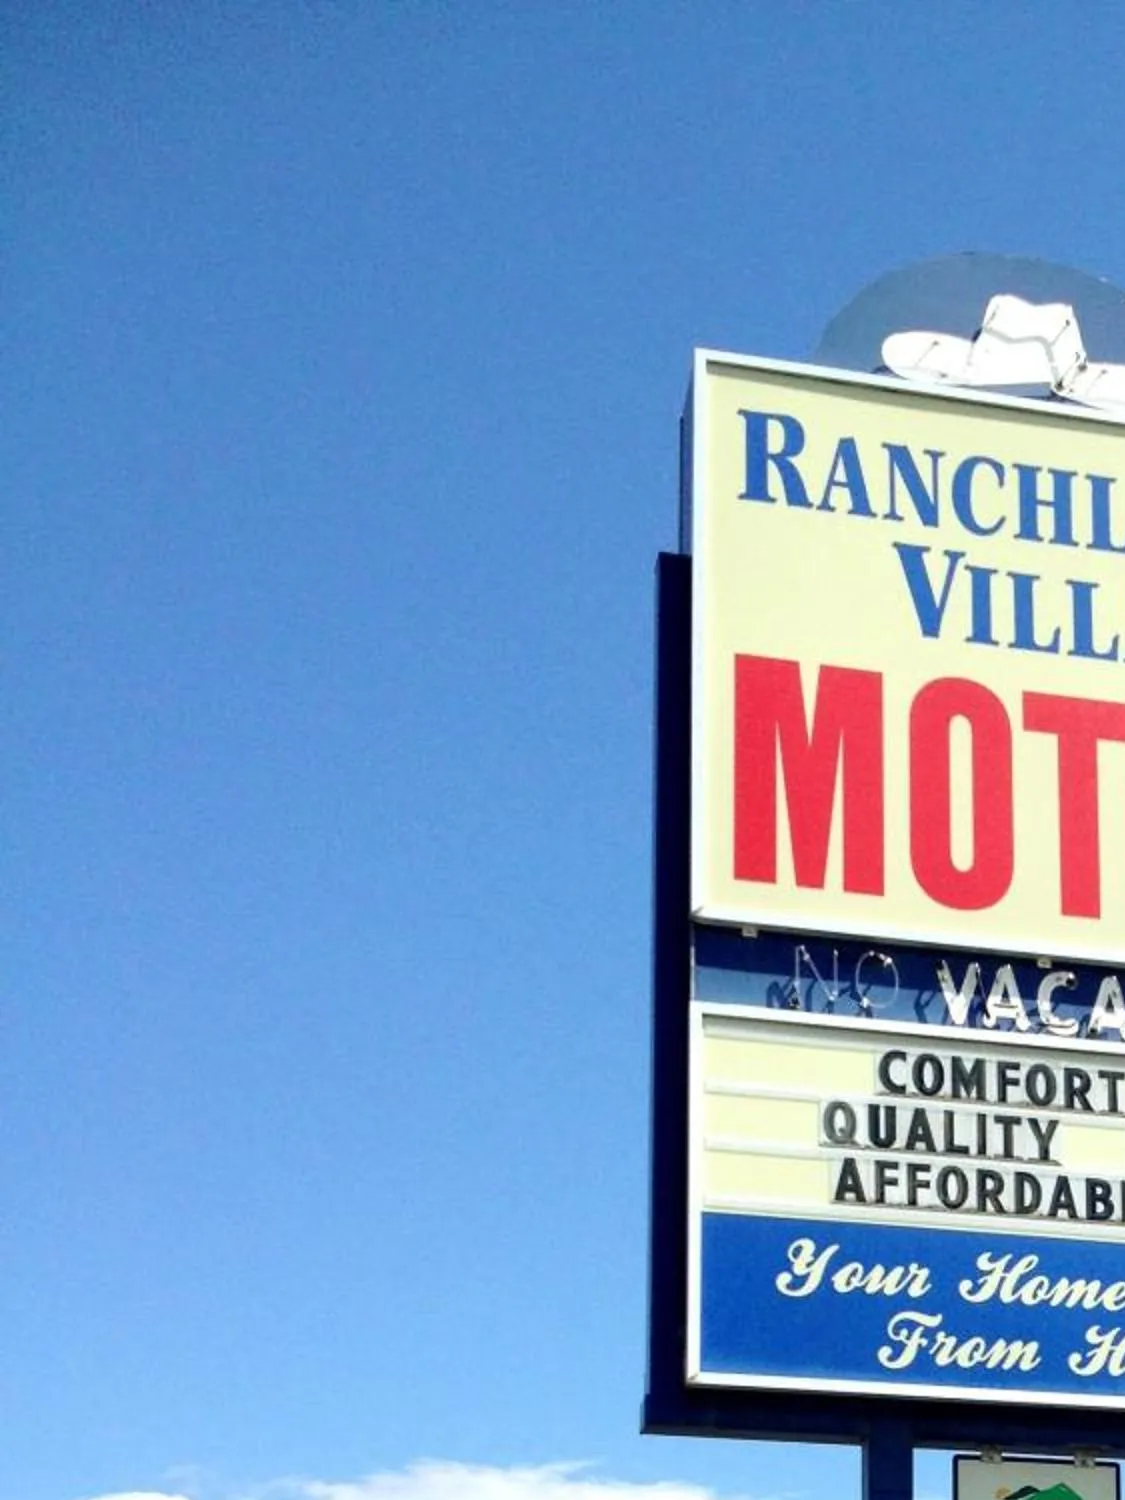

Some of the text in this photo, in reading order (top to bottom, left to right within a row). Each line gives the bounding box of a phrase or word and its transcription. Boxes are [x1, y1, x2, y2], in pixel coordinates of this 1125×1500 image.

[794, 944, 899, 1010] NO
[877, 1049, 1125, 1114] COMFORT
[822, 1100, 1060, 1163] QUALITY
[775, 1238, 932, 1298] Your
[877, 1312, 1040, 1370] From
